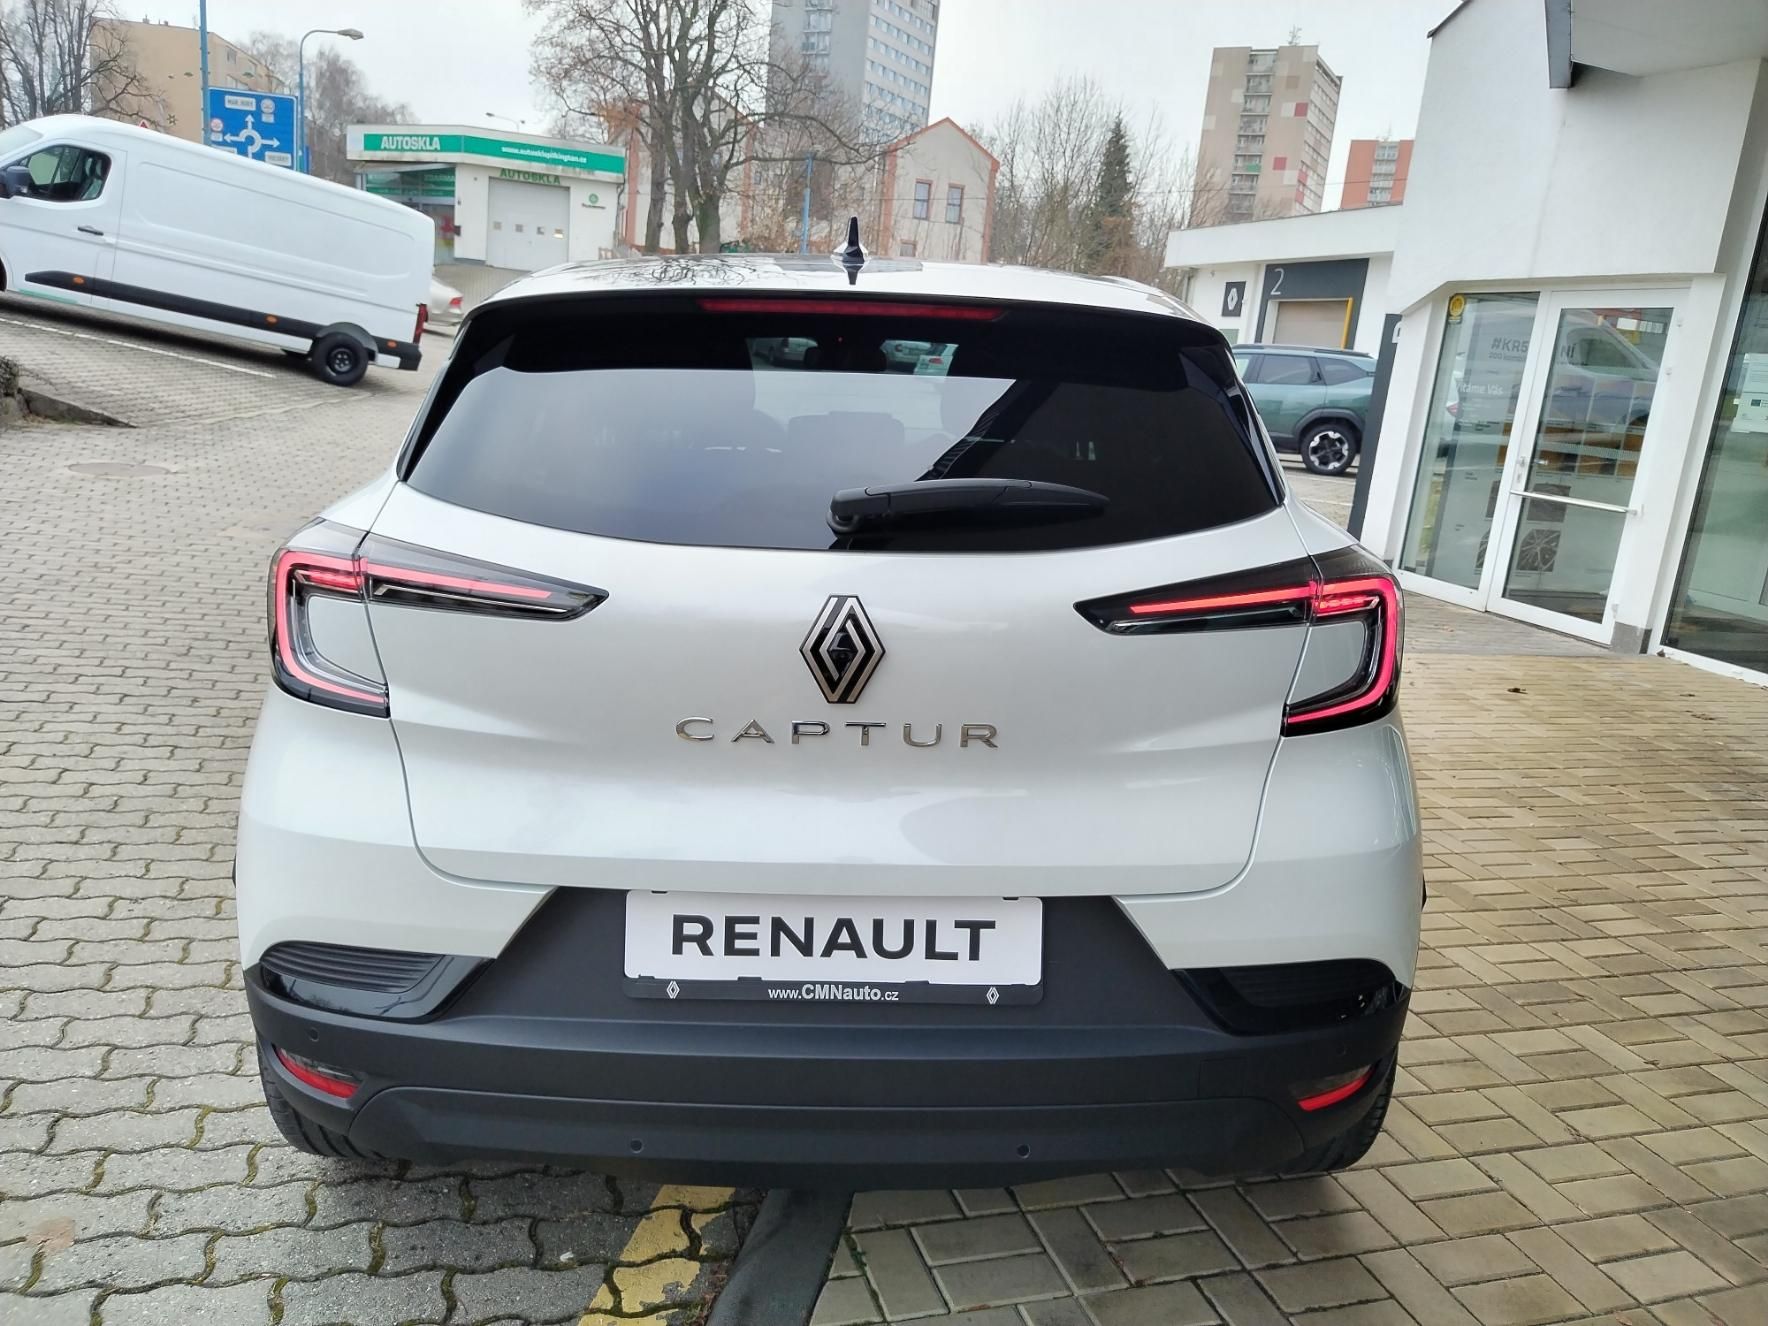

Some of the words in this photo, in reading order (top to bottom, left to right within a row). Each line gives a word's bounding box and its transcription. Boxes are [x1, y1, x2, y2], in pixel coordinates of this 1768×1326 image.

[380, 135, 441, 150] AUTOSKLA
[499, 167, 562, 185] AUTOSKLA
[1270, 267, 1285, 296] 2
[675, 715, 999, 748] CAPTUR
[670, 912, 997, 962] RENAULT
[767, 983, 899, 1001] www.CMNauto.cz
